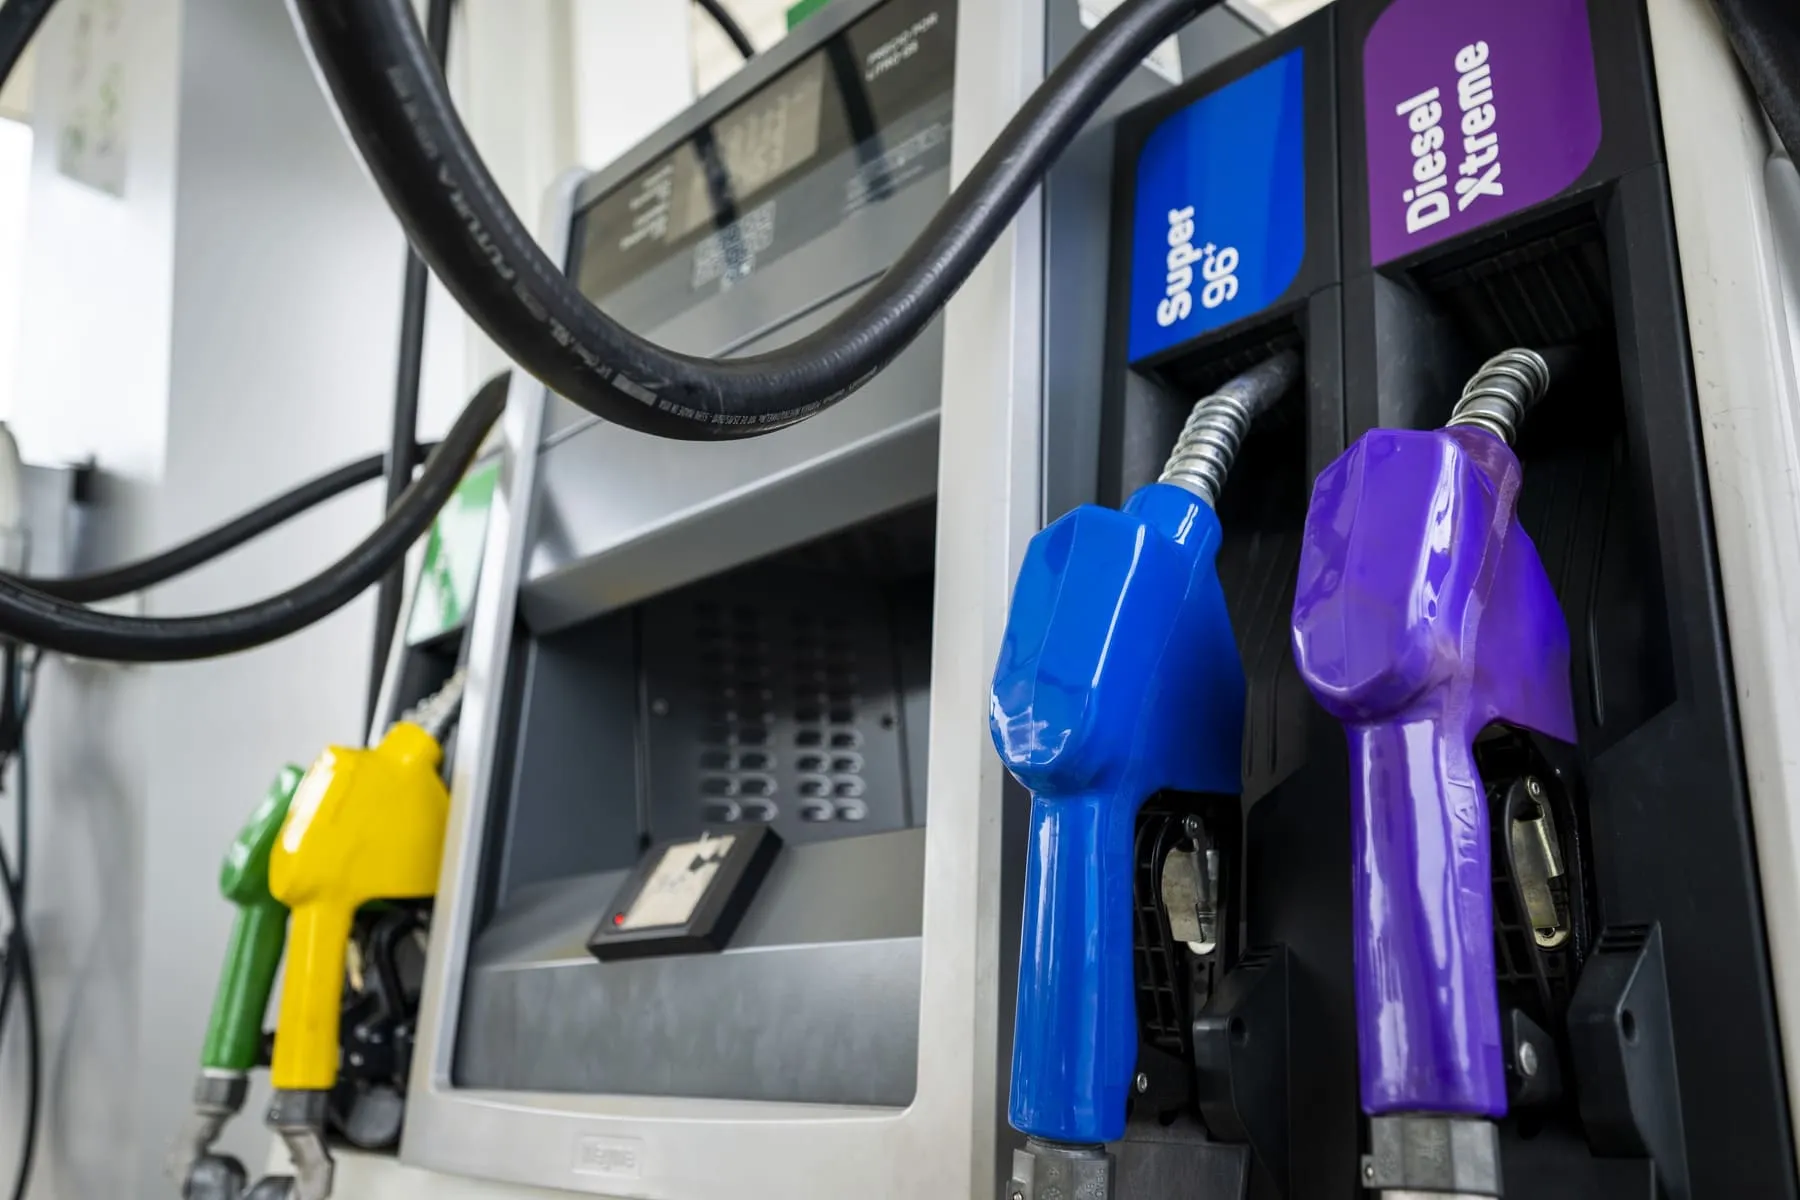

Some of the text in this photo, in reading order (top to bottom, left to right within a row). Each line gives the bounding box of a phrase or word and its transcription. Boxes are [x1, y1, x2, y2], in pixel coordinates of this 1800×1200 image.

[1396, 86, 1450, 234] Diesel
[1455, 40, 1504, 212] Xtreme
[1156, 205, 1203, 327] Super
